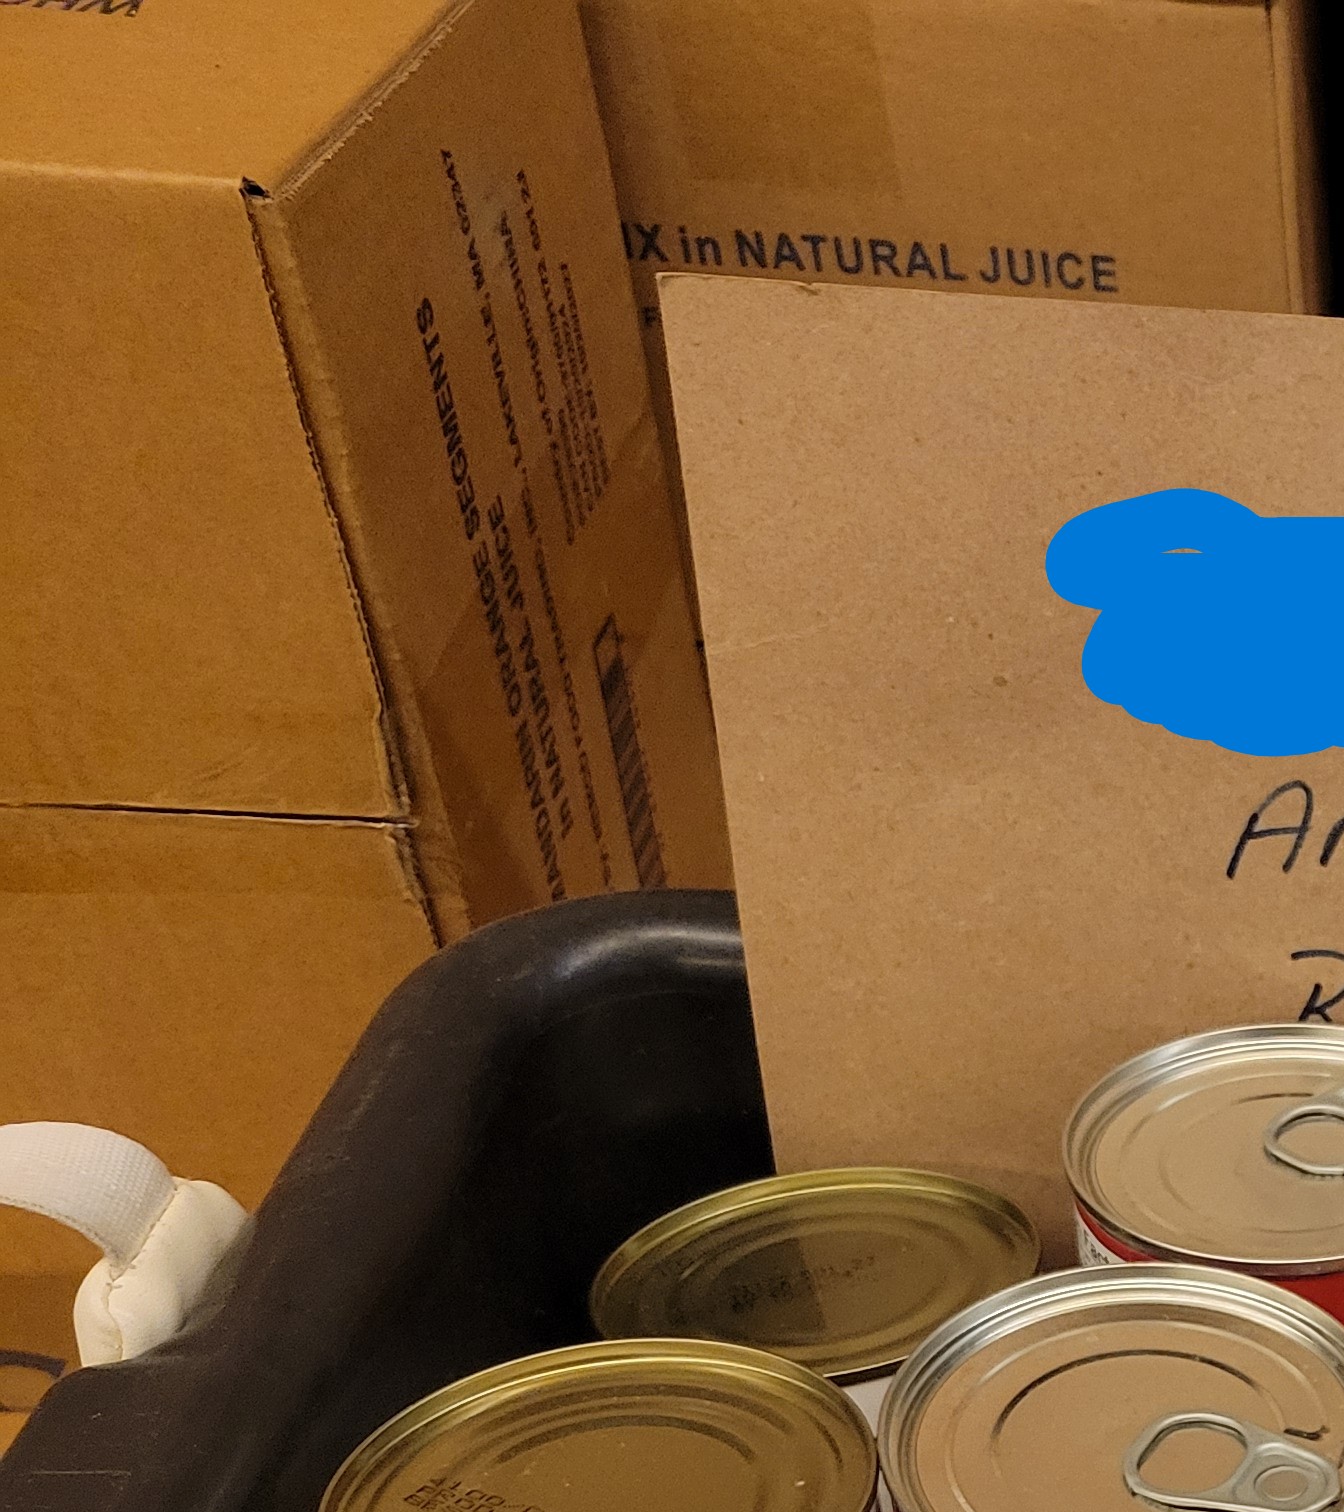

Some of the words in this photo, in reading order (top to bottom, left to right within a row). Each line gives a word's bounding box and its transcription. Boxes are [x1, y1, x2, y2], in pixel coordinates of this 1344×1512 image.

[467, 237, 485, 291] MA
[680, 226, 723, 266] in
[735, 229, 967, 282] NATURAL
[980, 246, 1120, 294] JUICE
[416, 297, 482, 541] SEGMENTS
[488, 494, 524, 611] JUICE
[473, 541, 523, 716] ORANGE
[519, 616, 565, 799] NATURAL
